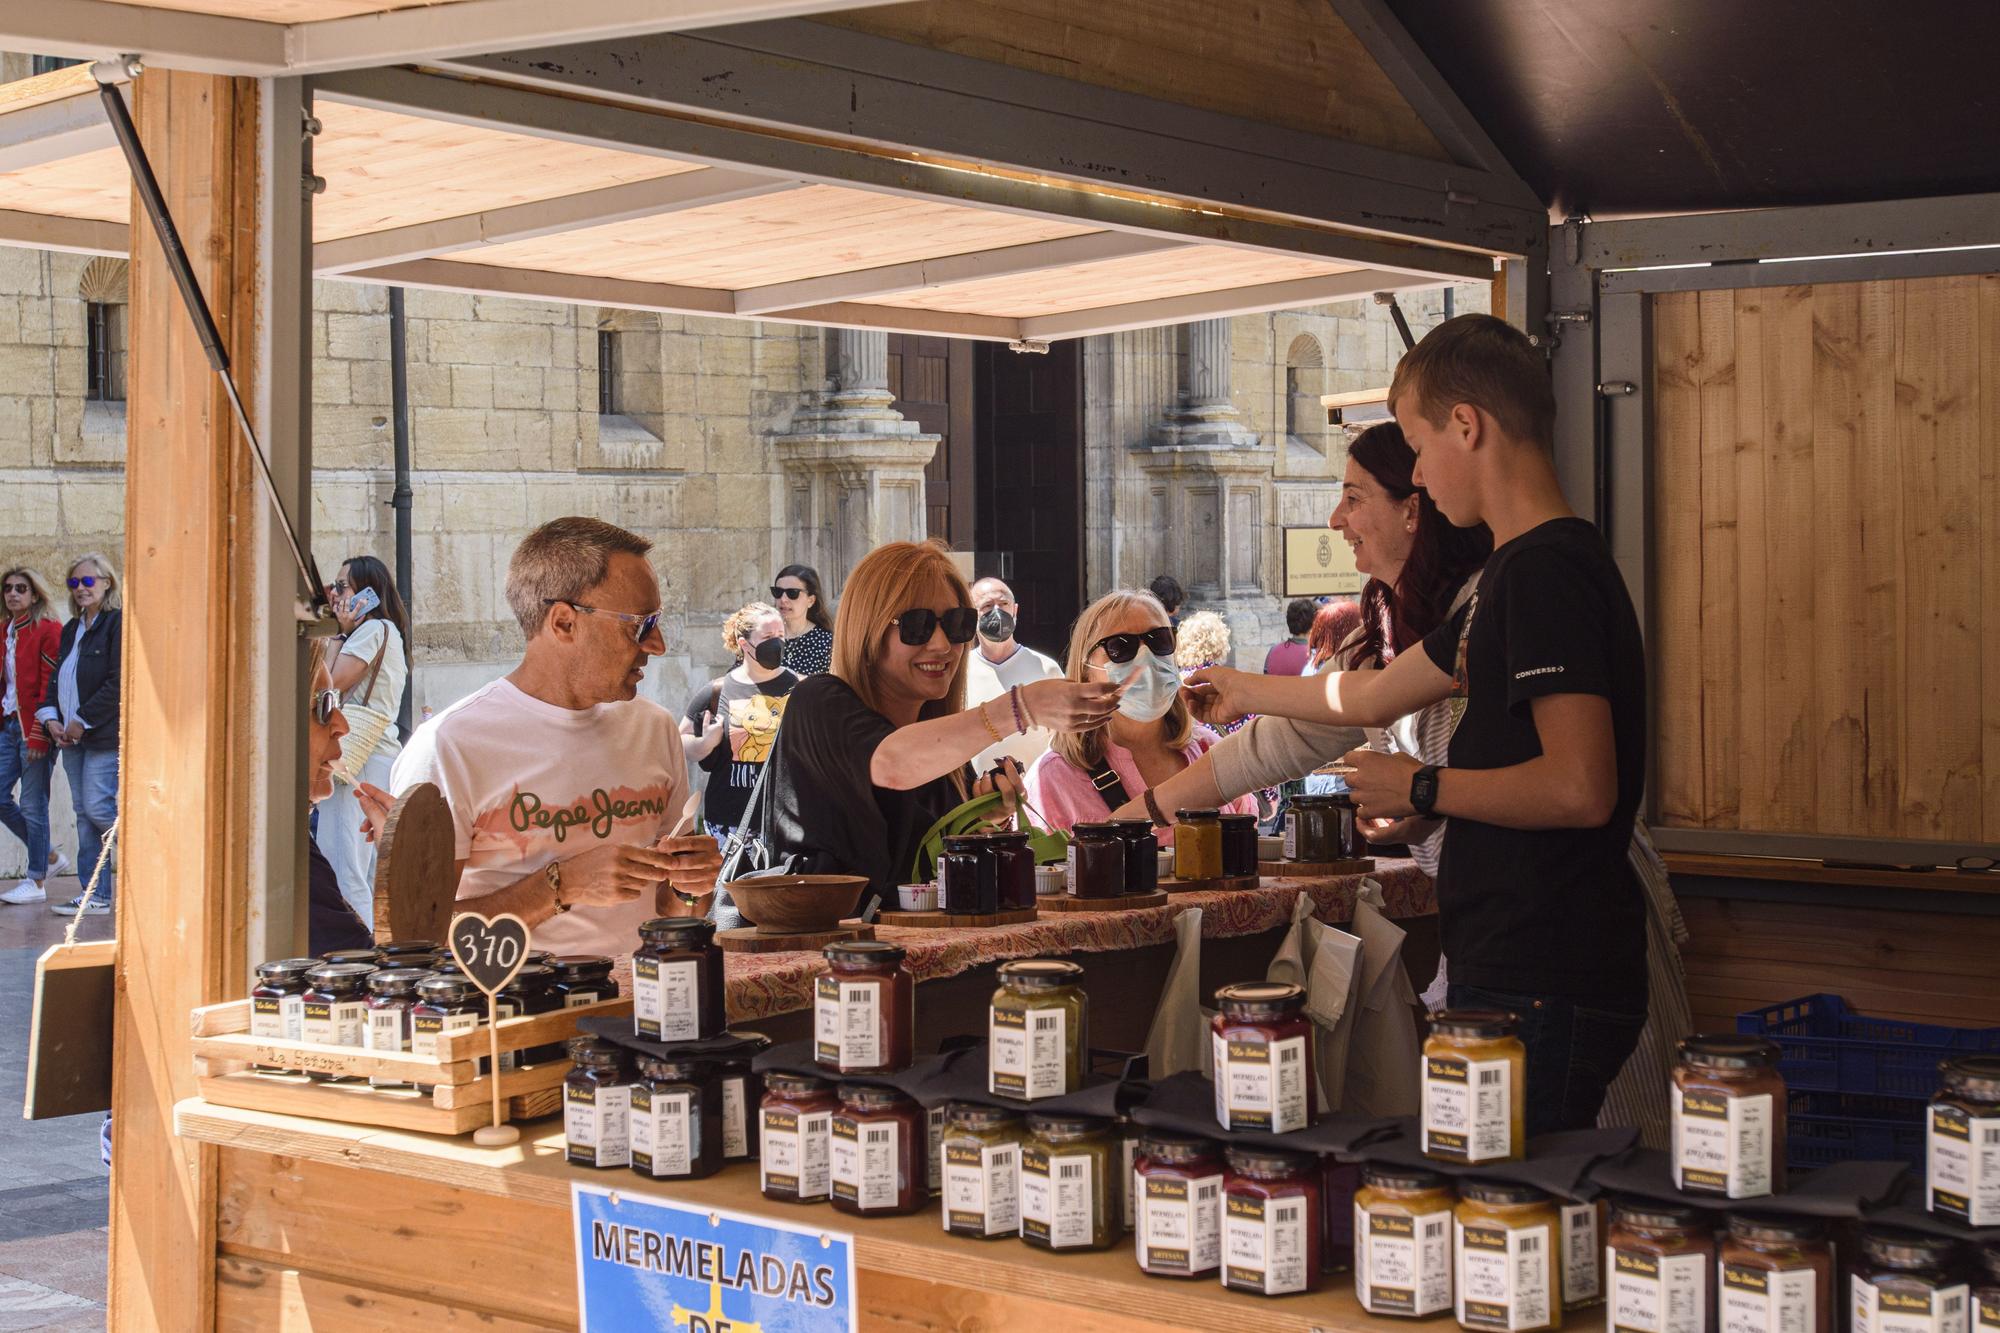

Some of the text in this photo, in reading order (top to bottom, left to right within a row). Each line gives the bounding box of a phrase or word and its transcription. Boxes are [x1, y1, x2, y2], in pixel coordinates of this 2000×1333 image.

[1515, 666, 1557, 679] CONVERSE
[510, 788, 664, 842] Pepe Jeans
[593, 1222, 834, 1308] MERMELADAS
